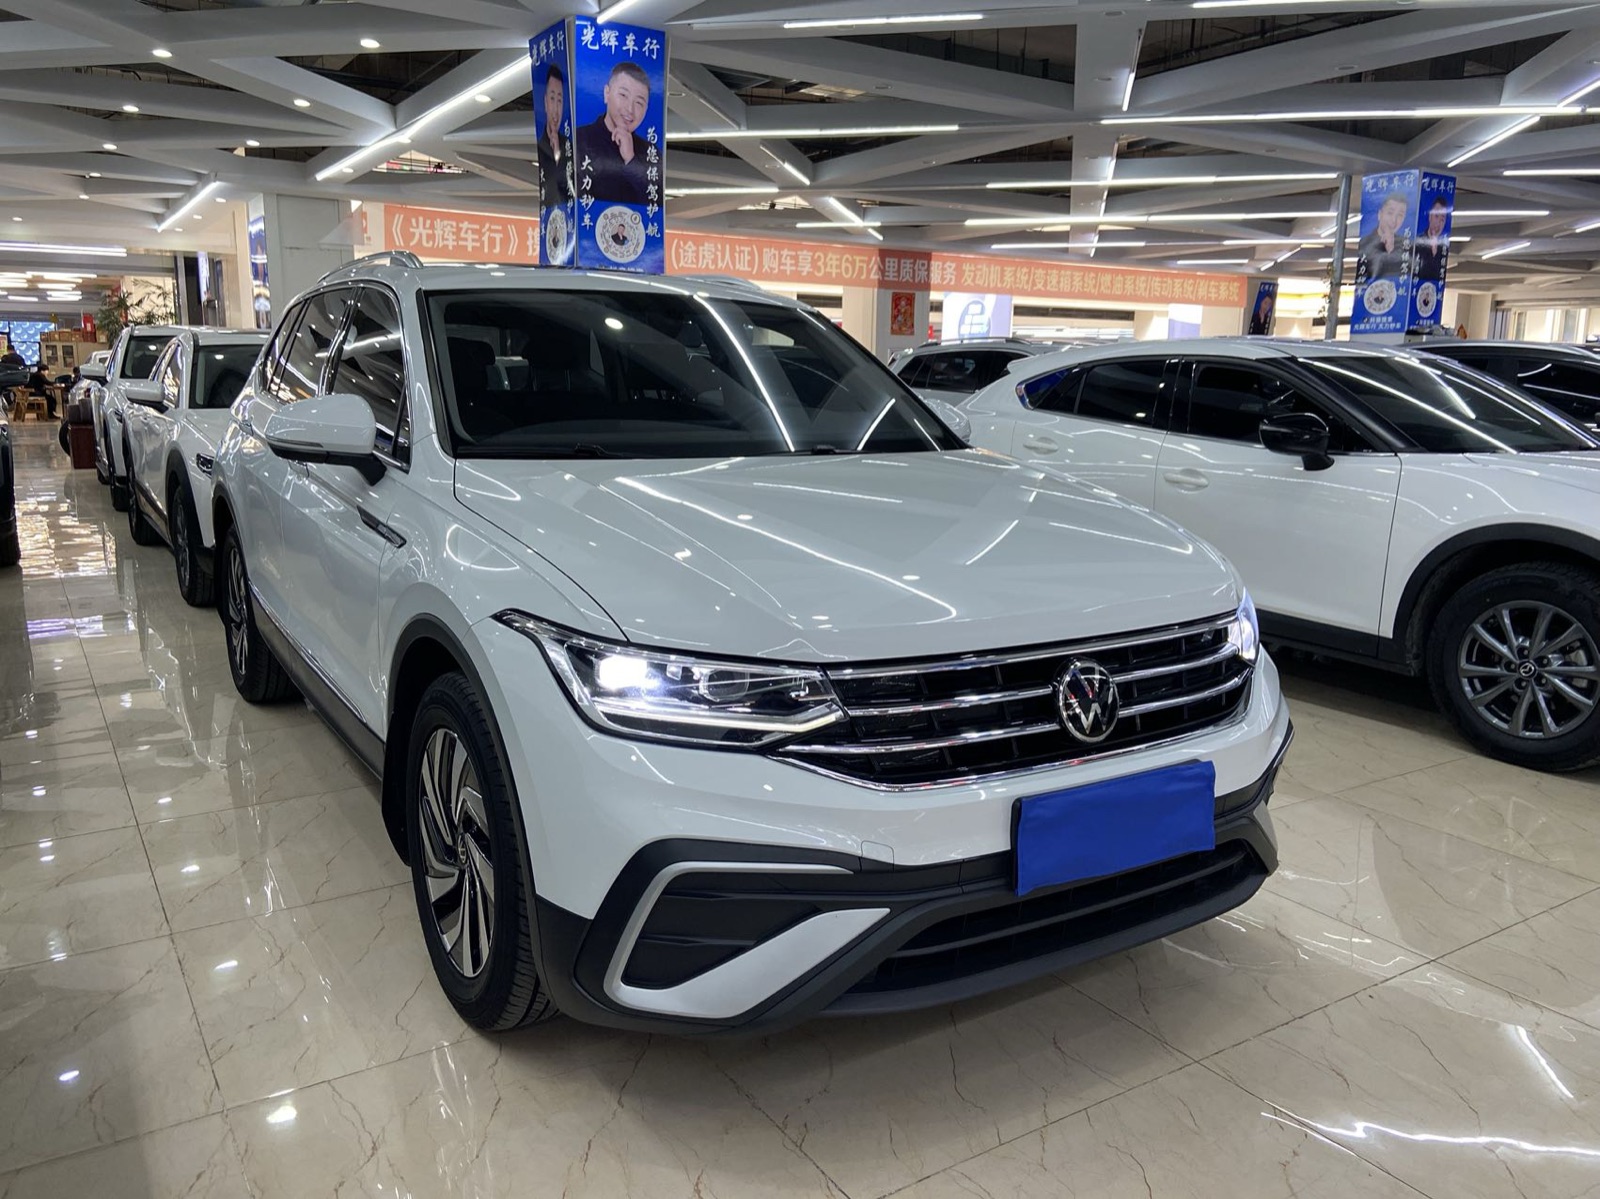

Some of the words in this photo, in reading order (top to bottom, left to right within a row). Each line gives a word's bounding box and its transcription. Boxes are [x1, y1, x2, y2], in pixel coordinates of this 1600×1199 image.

[581, 24, 660, 59] 光辉车行
[646, 126, 661, 238] 为您保驾护航
